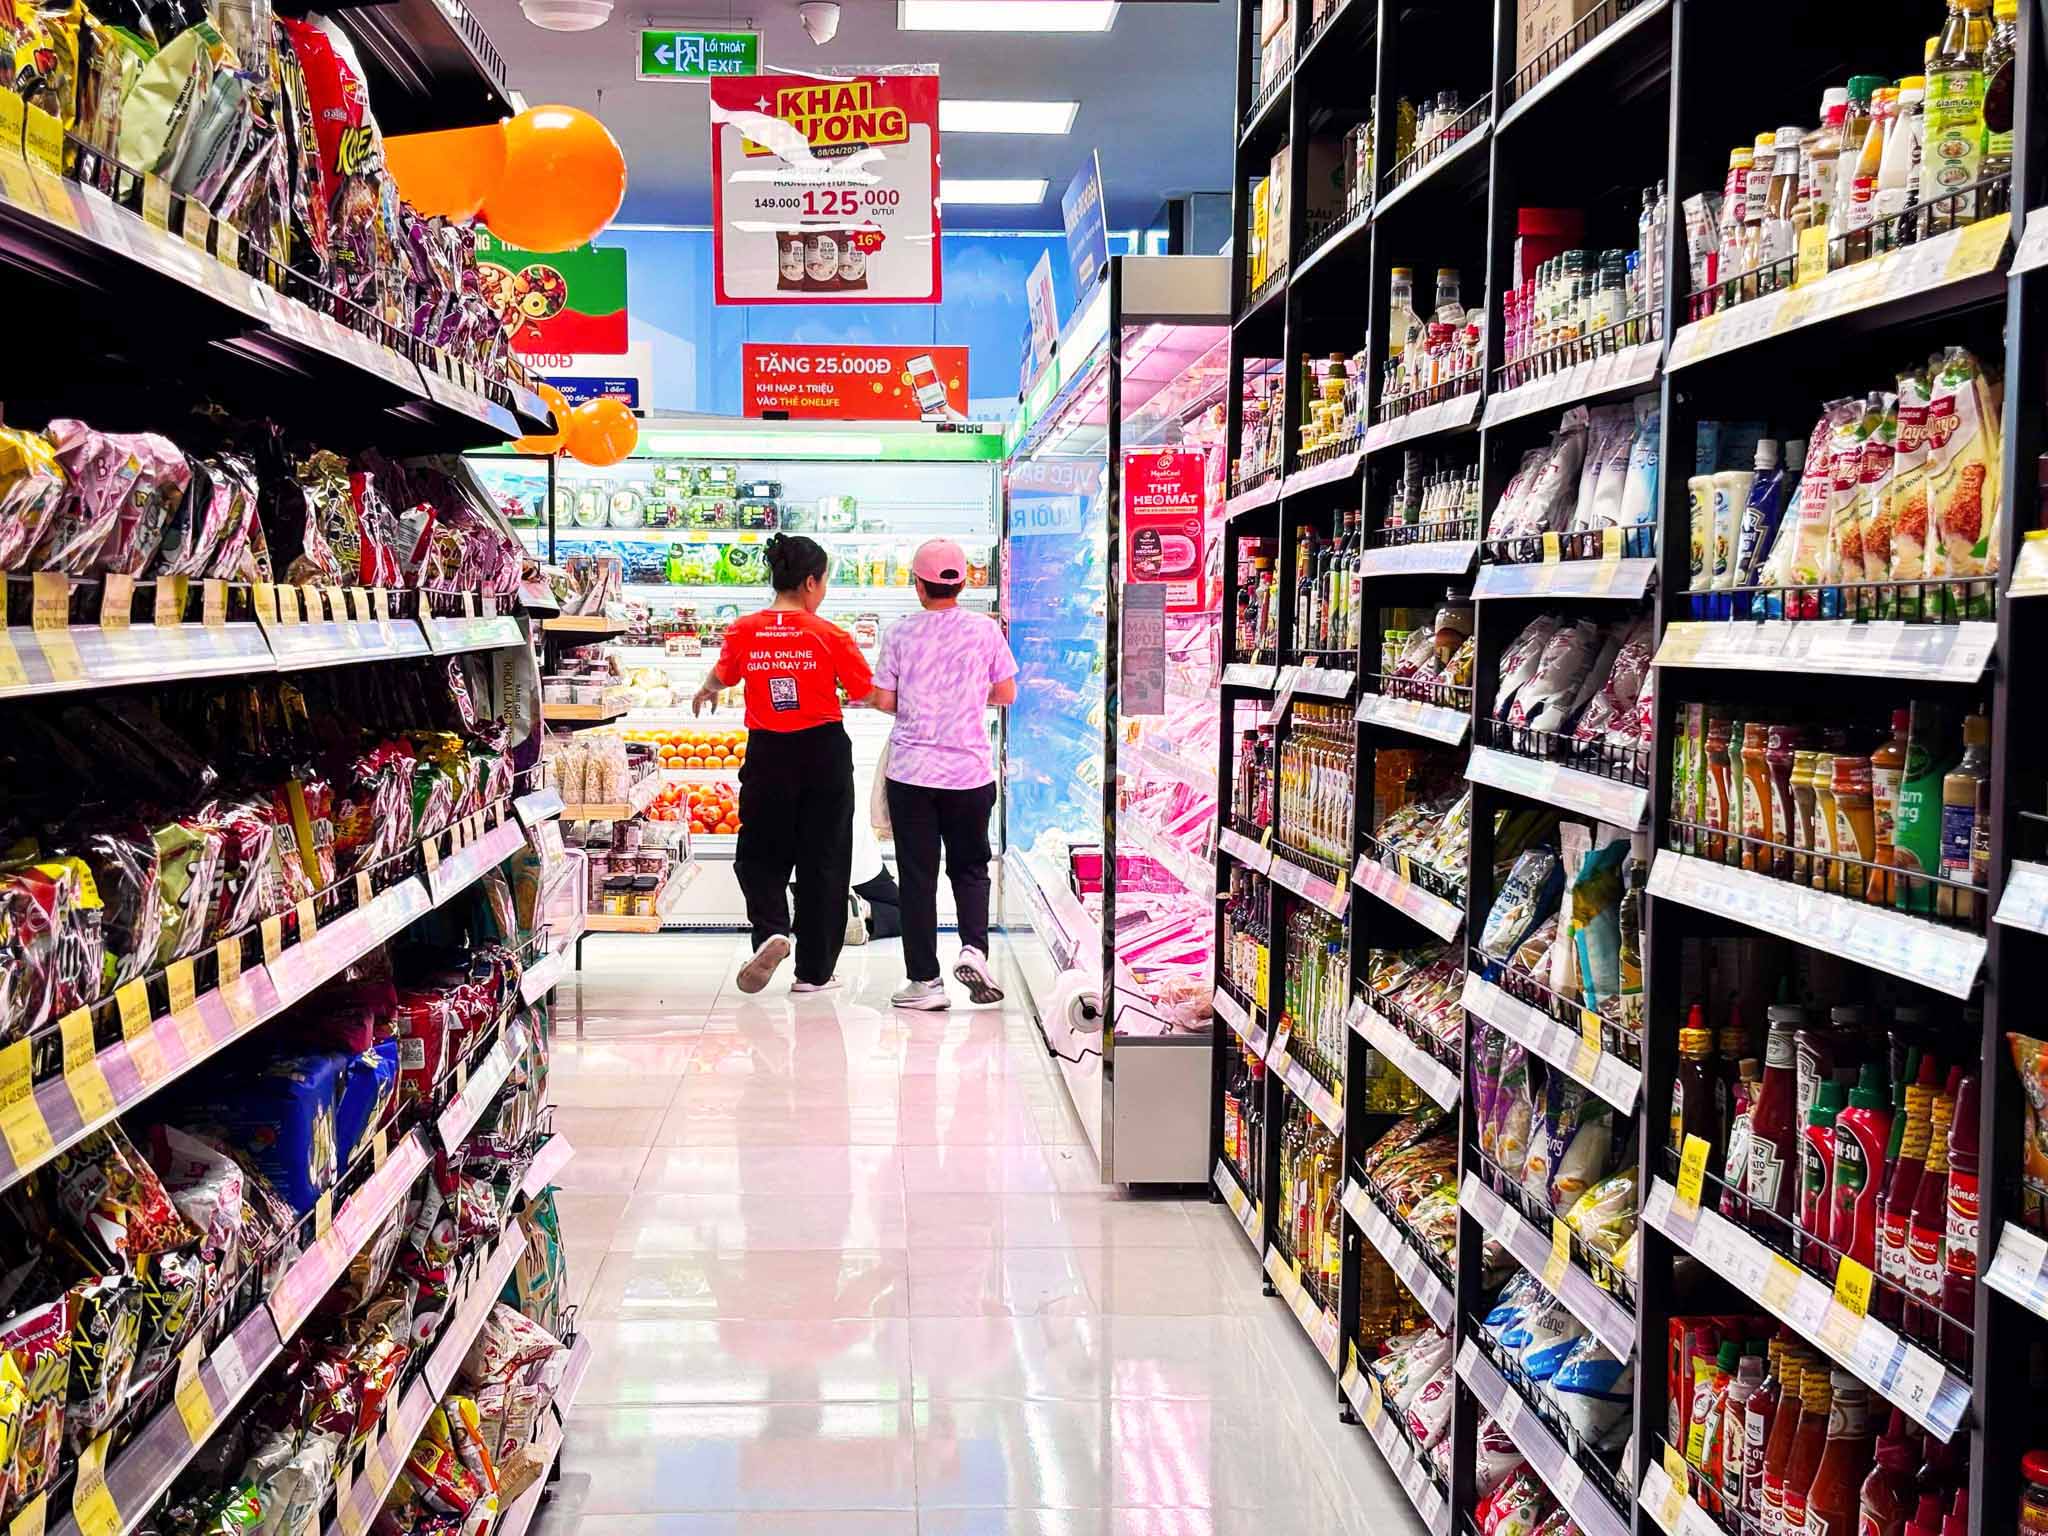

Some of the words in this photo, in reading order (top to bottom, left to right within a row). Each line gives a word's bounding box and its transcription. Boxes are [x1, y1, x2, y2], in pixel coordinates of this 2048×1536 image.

[704, 38, 718, 53] LỐI
[719, 40, 746, 53] THOÁT
[707, 59, 743, 72] EXIT
[781, 86, 870, 118] KHAI
[754, 197, 801, 209] 149.000
[524, 353, 574, 368] 000Đ
[756, 352, 811, 377] TẶNG
[815, 357, 892, 375] 25.000Đ
[756, 383, 773, 394] KHI
[775, 384, 795, 396] NẠP
[798, 385, 804, 394] 1
[805, 382, 834, 395] TRIỆU
[756, 396, 778, 407] VÀO
[780, 396, 799, 407] THẺ
[801, 398, 841, 408] ONELIFE
[1147, 482, 1181, 495] THỊT
[750, 651, 771, 659] MUA
[774, 650, 813, 659] ONLINE
[747, 662, 770, 671] GIAO
[771, 661, 801, 671] NGAY
[803, 661, 817, 670] 2H
[503, 693, 513, 720] LANG
